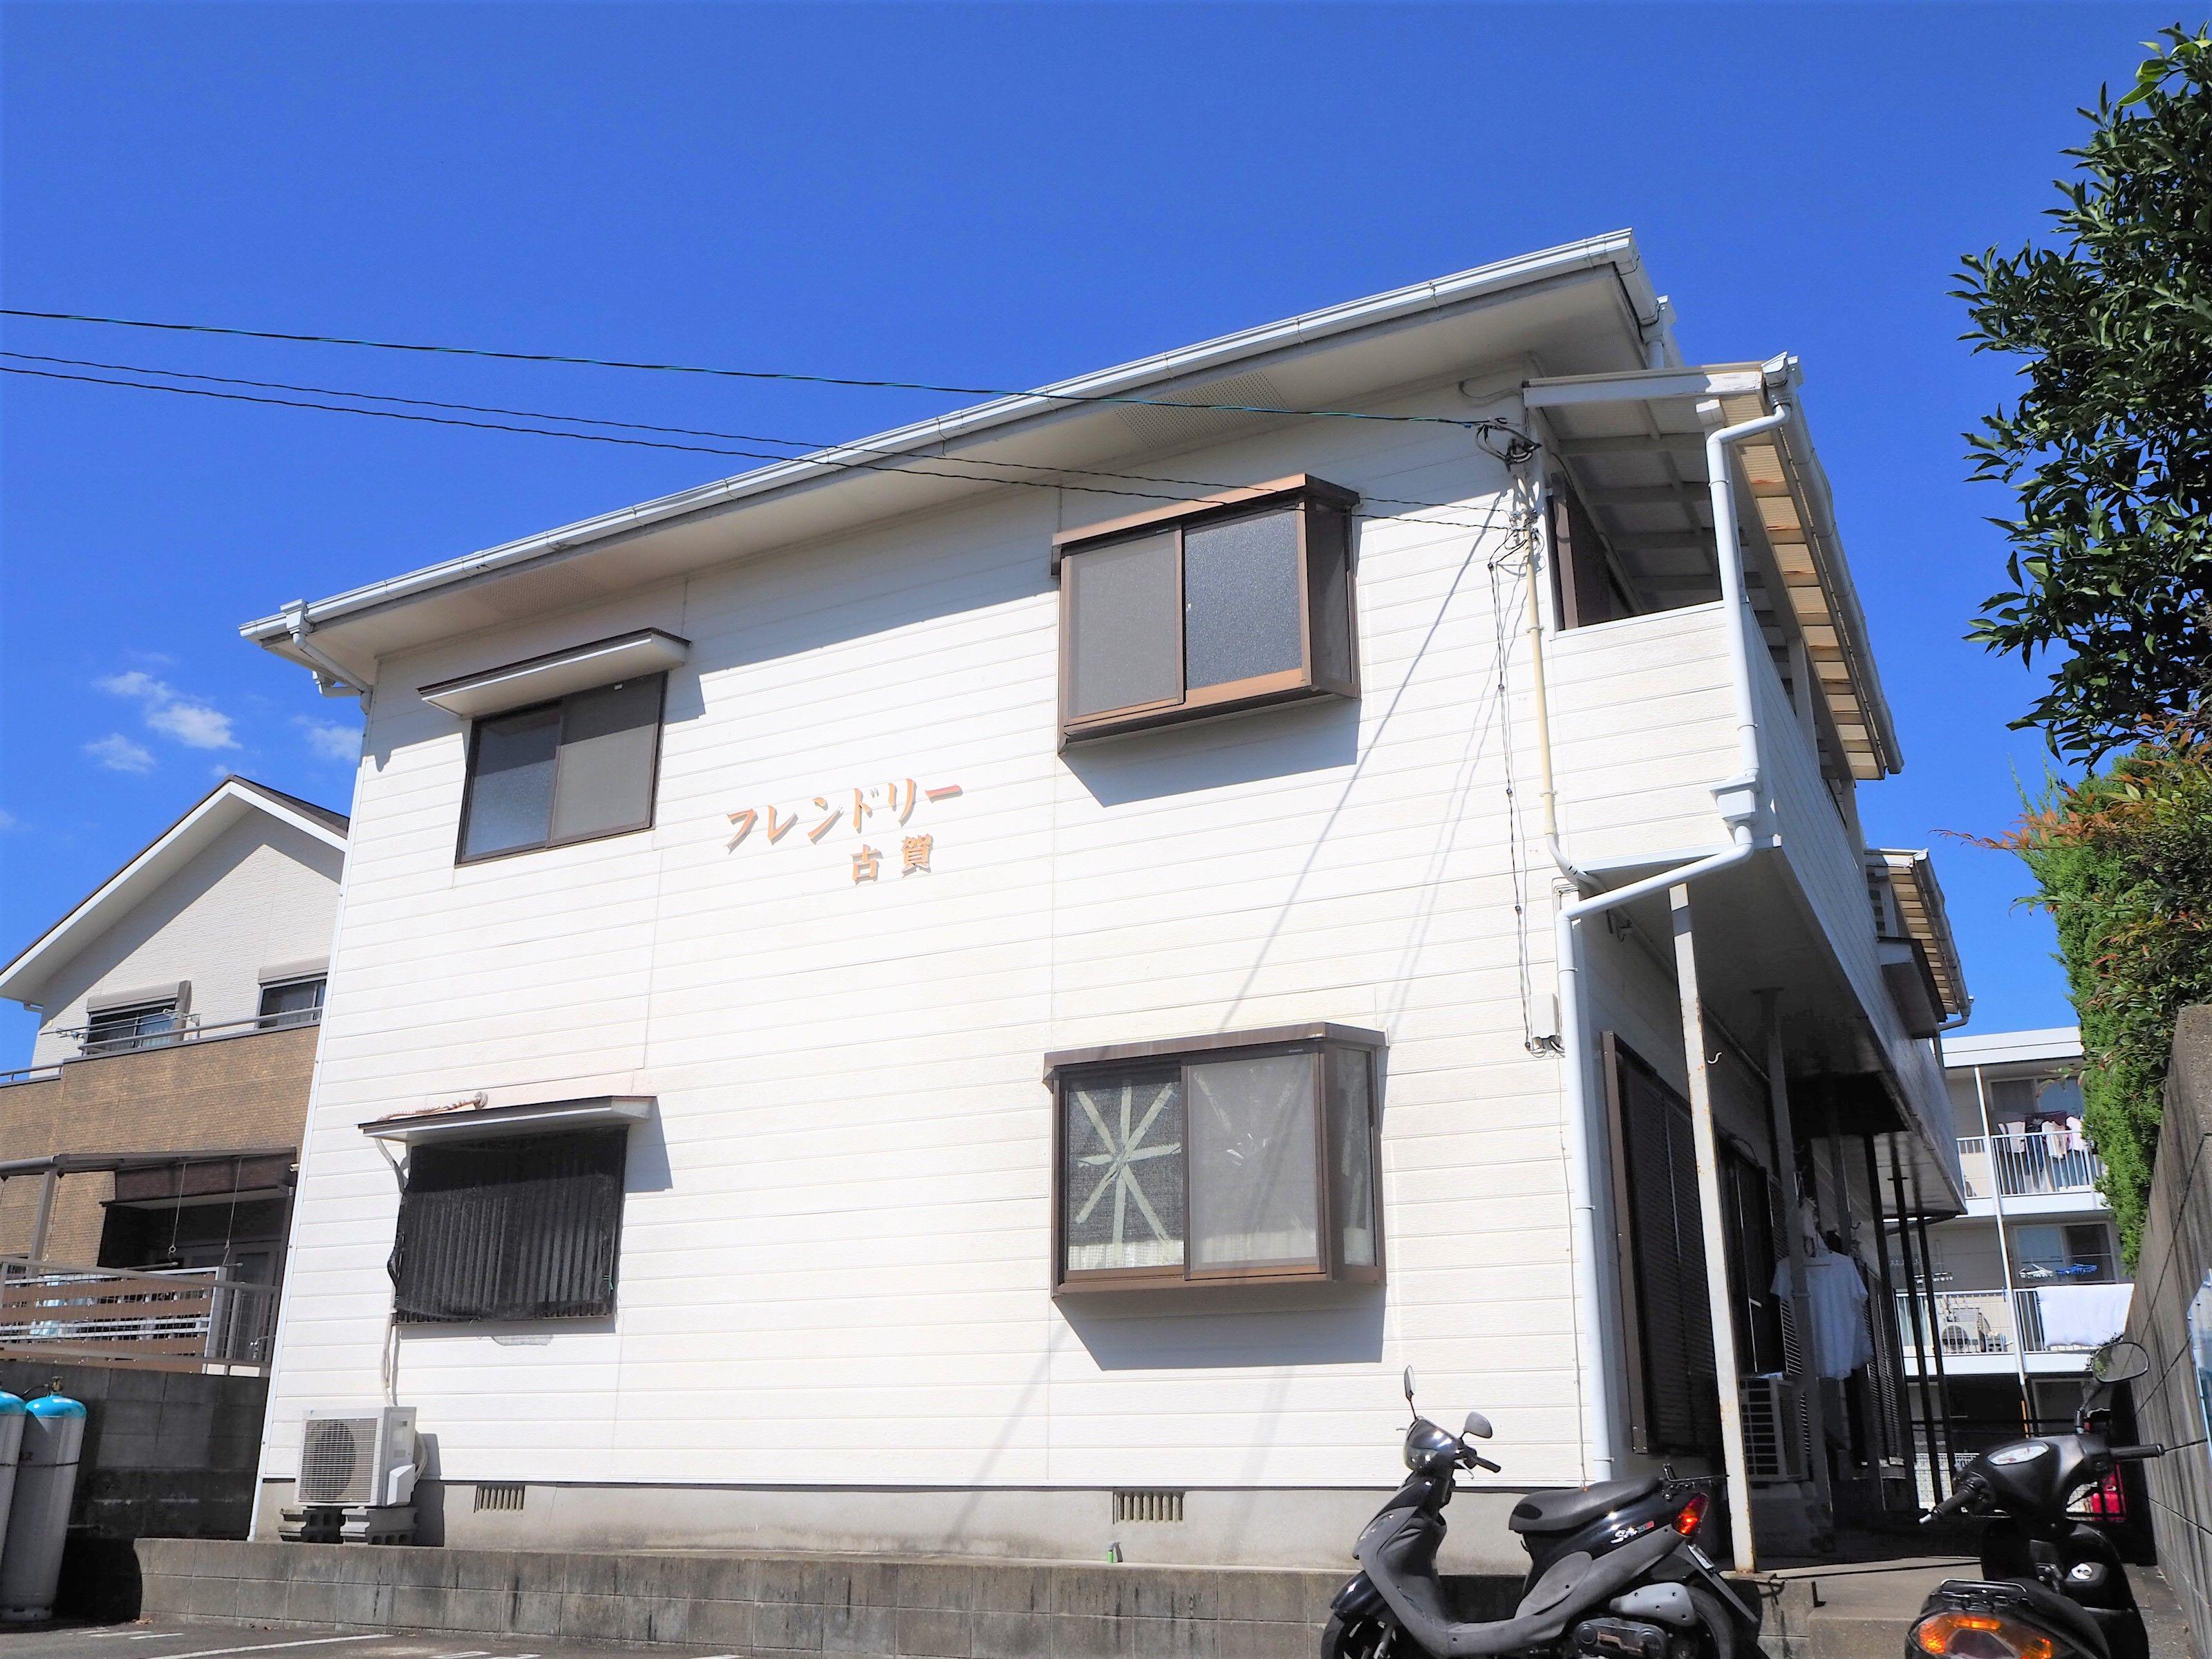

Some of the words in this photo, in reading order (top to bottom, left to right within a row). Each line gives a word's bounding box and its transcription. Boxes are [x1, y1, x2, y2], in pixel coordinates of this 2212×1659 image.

[725, 778, 962, 853] フレンドリー
[851, 834, 933, 884] 古賀
